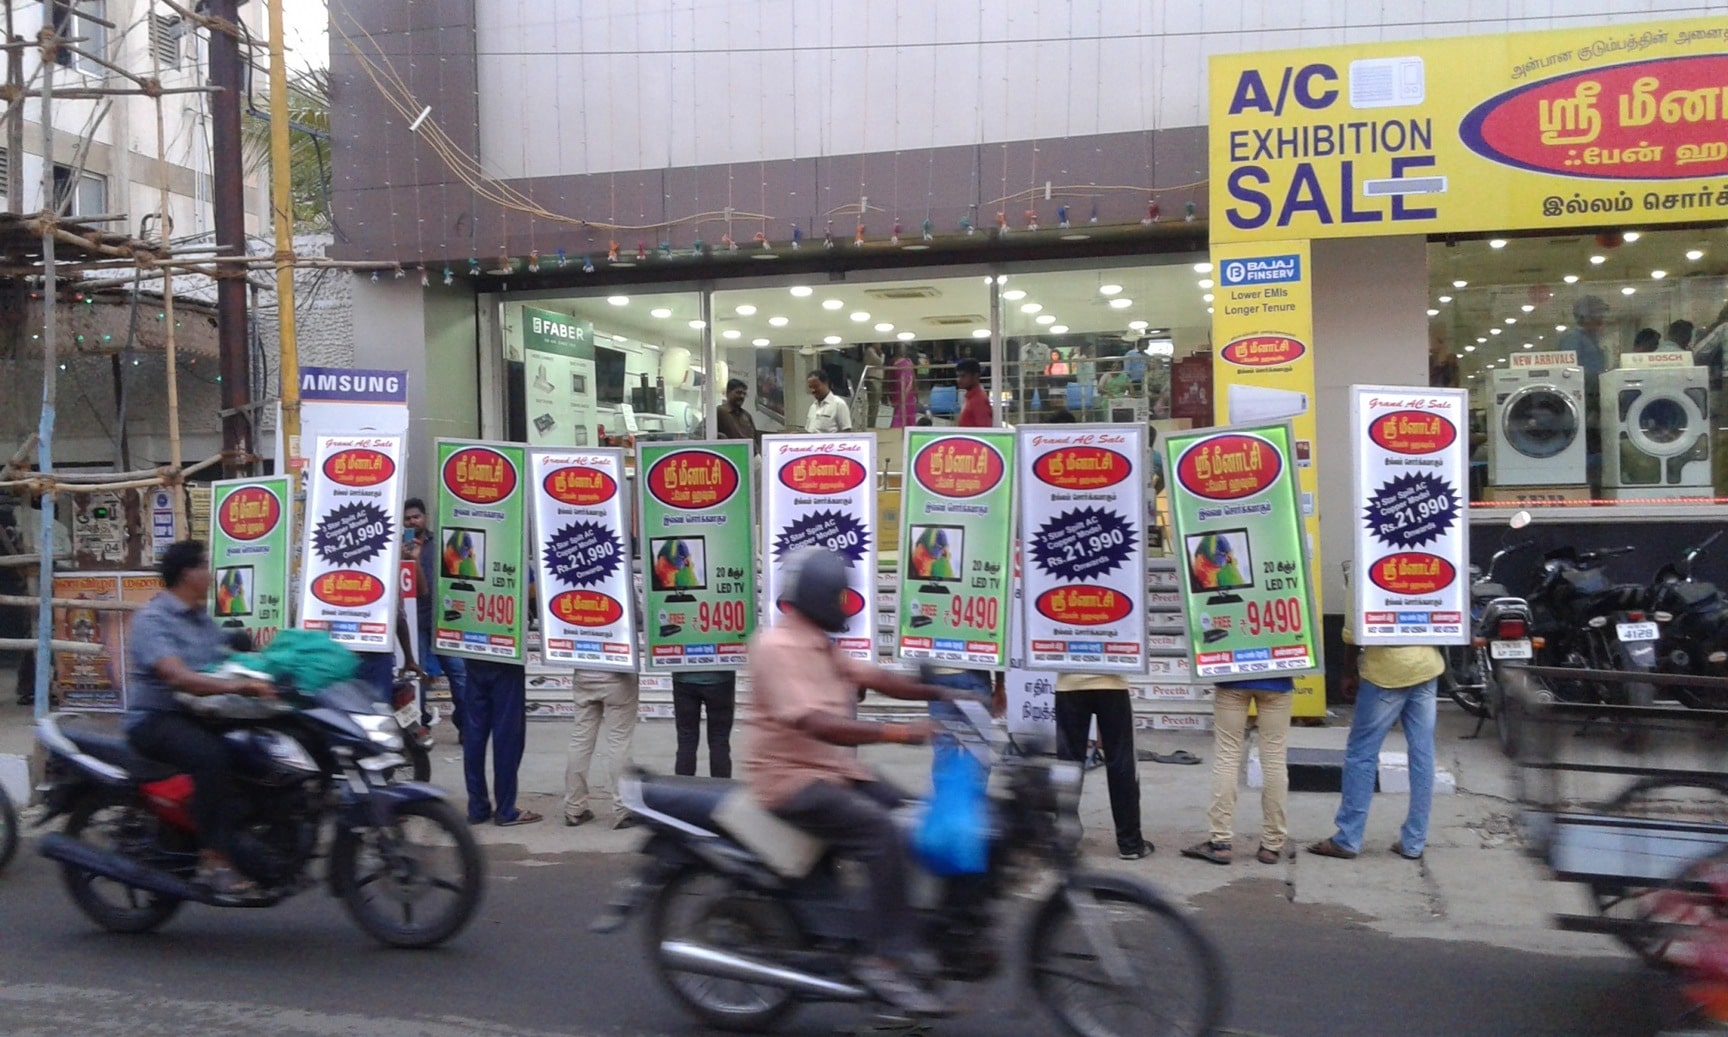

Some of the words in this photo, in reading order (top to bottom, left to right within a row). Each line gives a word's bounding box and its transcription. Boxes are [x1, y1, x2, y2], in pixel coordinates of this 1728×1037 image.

[1228, 63, 1340, 116] A/C
[1539, 81, 1602, 146] ஸ்ரீ
[1230, 118, 1433, 162] EXHIBITION
[1225, 155, 1437, 230] SALE
[1543, 190, 1634, 217] இல்லம்
[1246, 259, 1295, 270] BAJAJ
[1246, 269, 1295, 281] FINSERV
[1231, 290, 1261, 300] Lower
[1264, 288, 1288, 298] EMIs
[1225, 304, 1259, 316] Longer
[1262, 303, 1296, 313] Tenure
[543, 320, 584, 341] FABER
[1513, 355, 1533, 366] NEW
[1535, 353, 1575, 366] ARRIVALS
[1648, 354, 1683, 362] BOSCH
[302, 374, 399, 393] AMSUNG
[1405, 399, 1425, 408] AC
[1428, 399, 1452, 408] Sale
[354, 439, 371, 447] AC
[373, 439, 393, 448] Sale
[1072, 435, 1095, 444] AC
[1098, 434, 1125, 443] Sale
[814, 443, 834, 453] AC
[837, 443, 861, 452] Sale
[572, 456, 588, 465] AC
[591, 457, 611, 465] Sale
[1265, 579, 1283, 591] LED
[1285, 577, 1298, 589] TV
[1624, 629, 1653, 638] 4128
